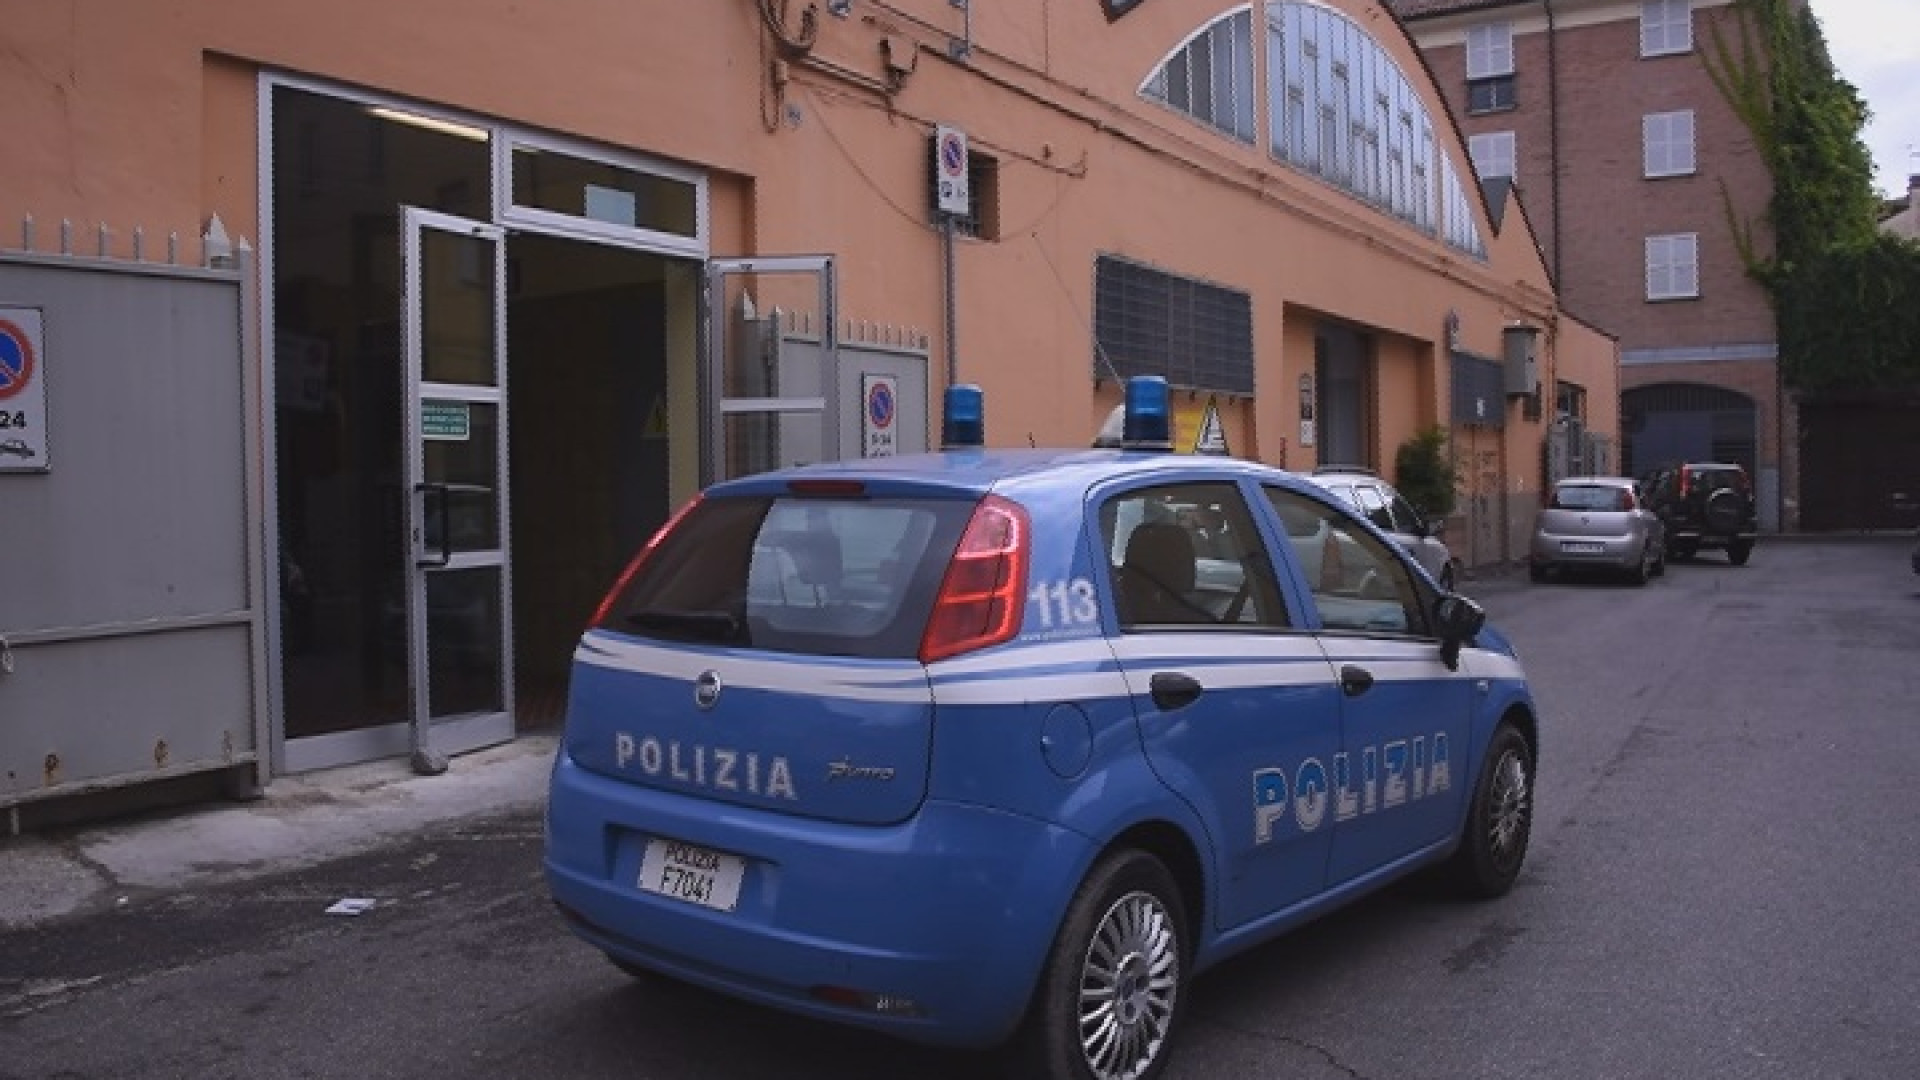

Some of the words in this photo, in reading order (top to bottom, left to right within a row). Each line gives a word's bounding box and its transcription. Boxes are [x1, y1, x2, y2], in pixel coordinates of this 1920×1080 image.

[1029, 577, 1097, 627] 113
[615, 732, 796, 799] POLIZIA
[1253, 731, 1449, 844] POLIZIA
[665, 843, 720, 872] POLIZIA
[660, 864, 715, 902] F7041
